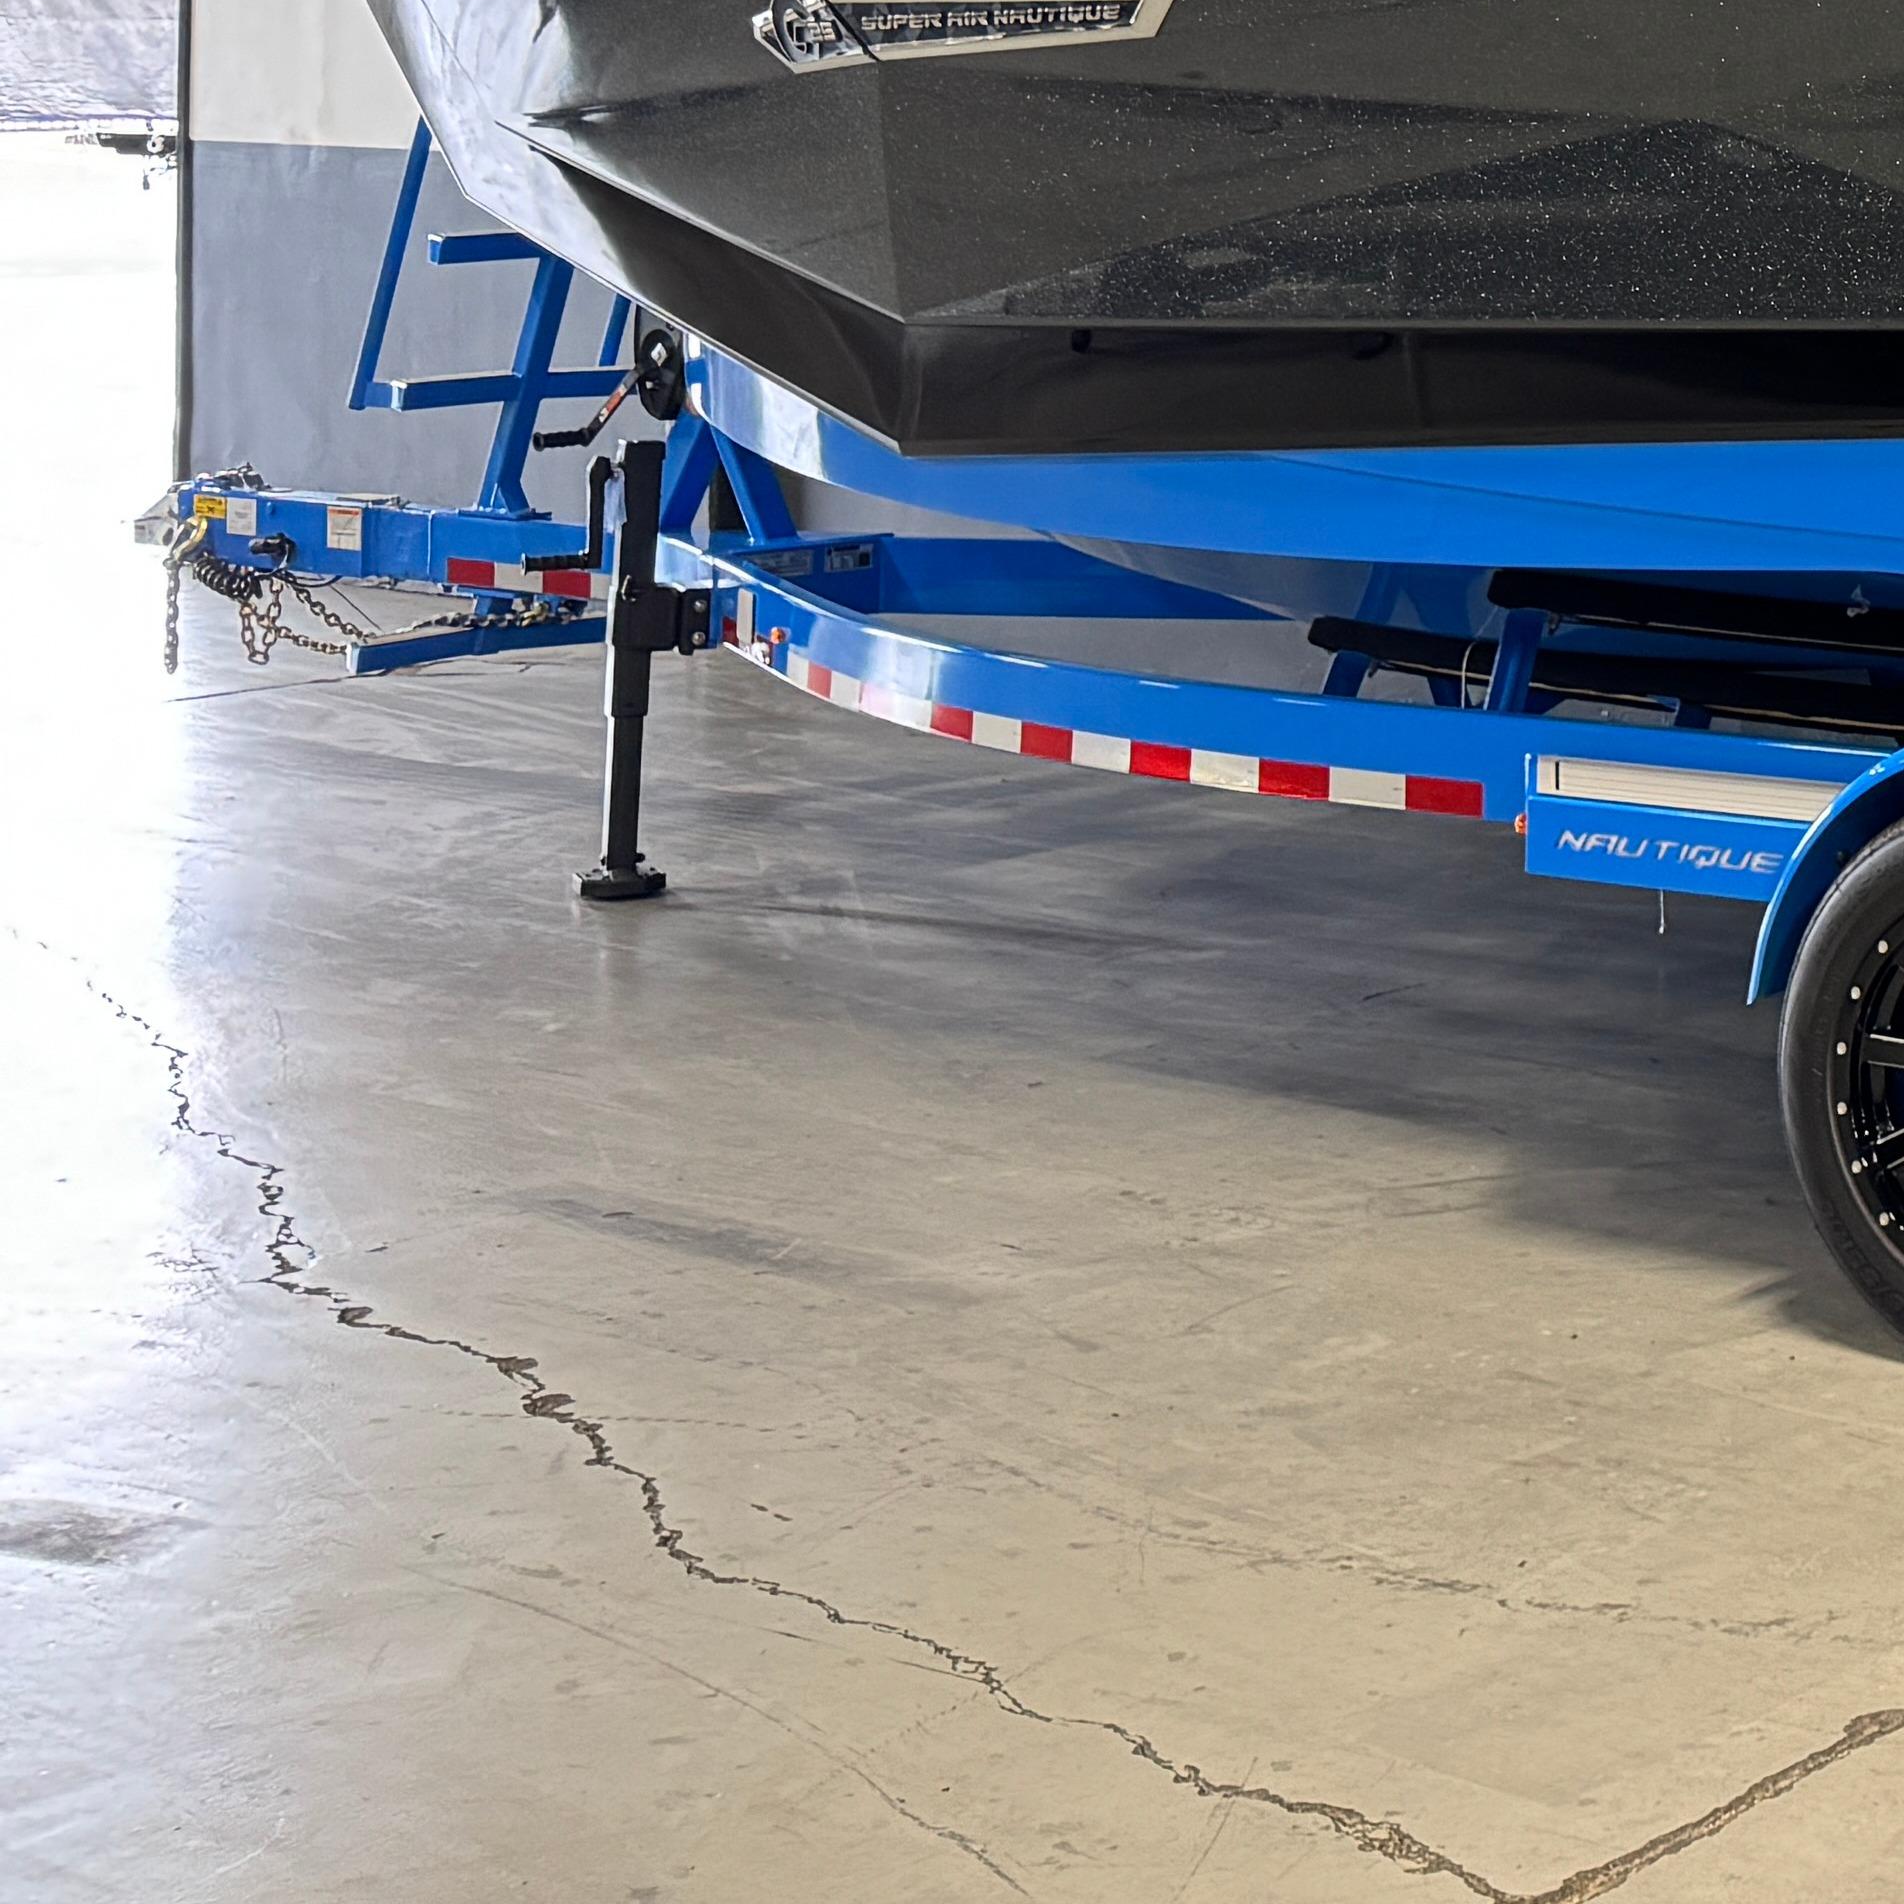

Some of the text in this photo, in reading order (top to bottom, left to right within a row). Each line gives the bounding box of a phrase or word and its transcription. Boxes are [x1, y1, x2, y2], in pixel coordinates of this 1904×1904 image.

[861, 9, 943, 31] SUPER
[947, 8, 988, 28] AIR
[993, 3, 1121, 27] NAUTIQUE
[1557, 829, 1785, 874] NAUTIQUE
